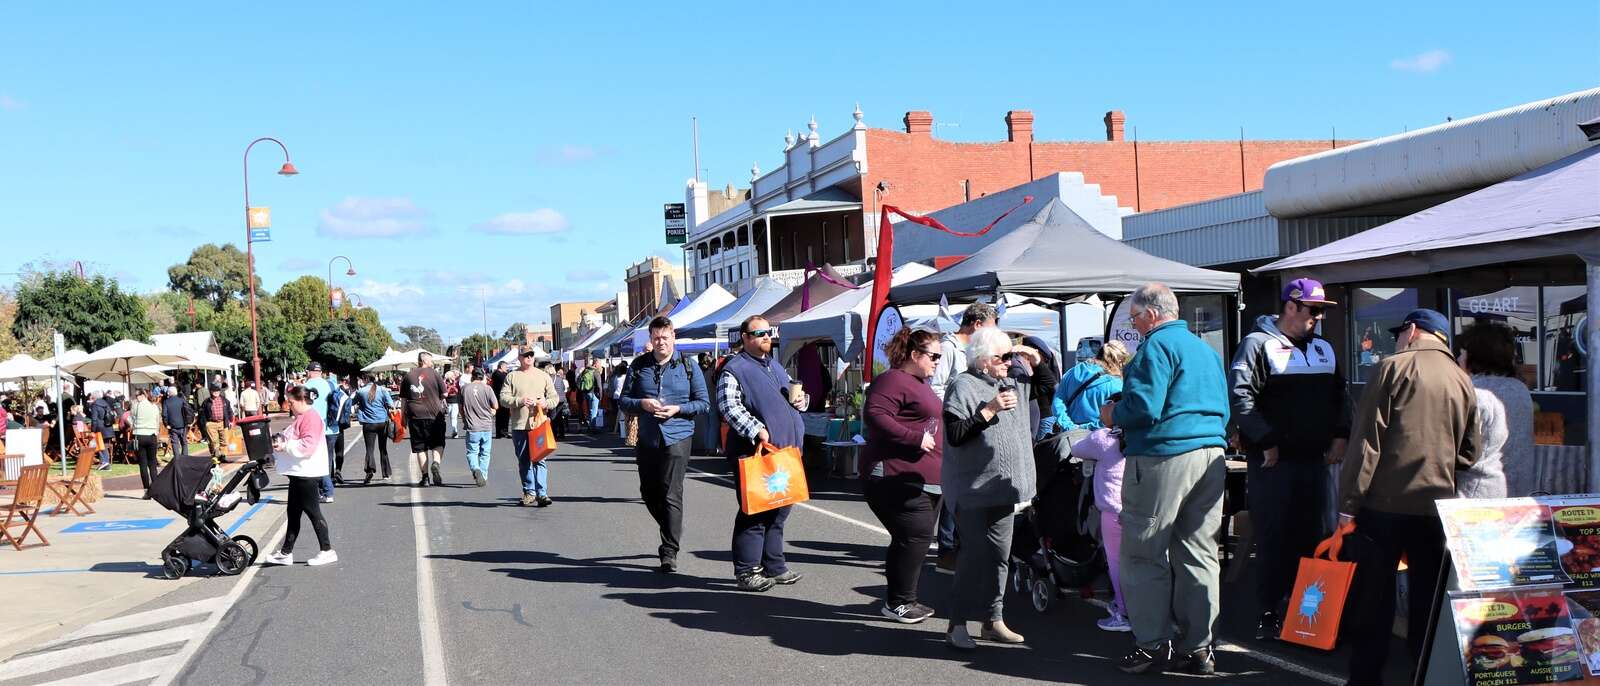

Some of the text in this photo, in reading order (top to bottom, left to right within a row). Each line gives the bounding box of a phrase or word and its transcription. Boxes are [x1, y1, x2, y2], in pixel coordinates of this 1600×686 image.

[1470, 296, 1519, 313] GO ART
[1116, 329, 1139, 341] Koa
[1497, 623, 1531, 631] BURGERS
[1554, 665, 1572, 673] BEEF
[1475, 671, 1516, 679] PORTUGUESE
